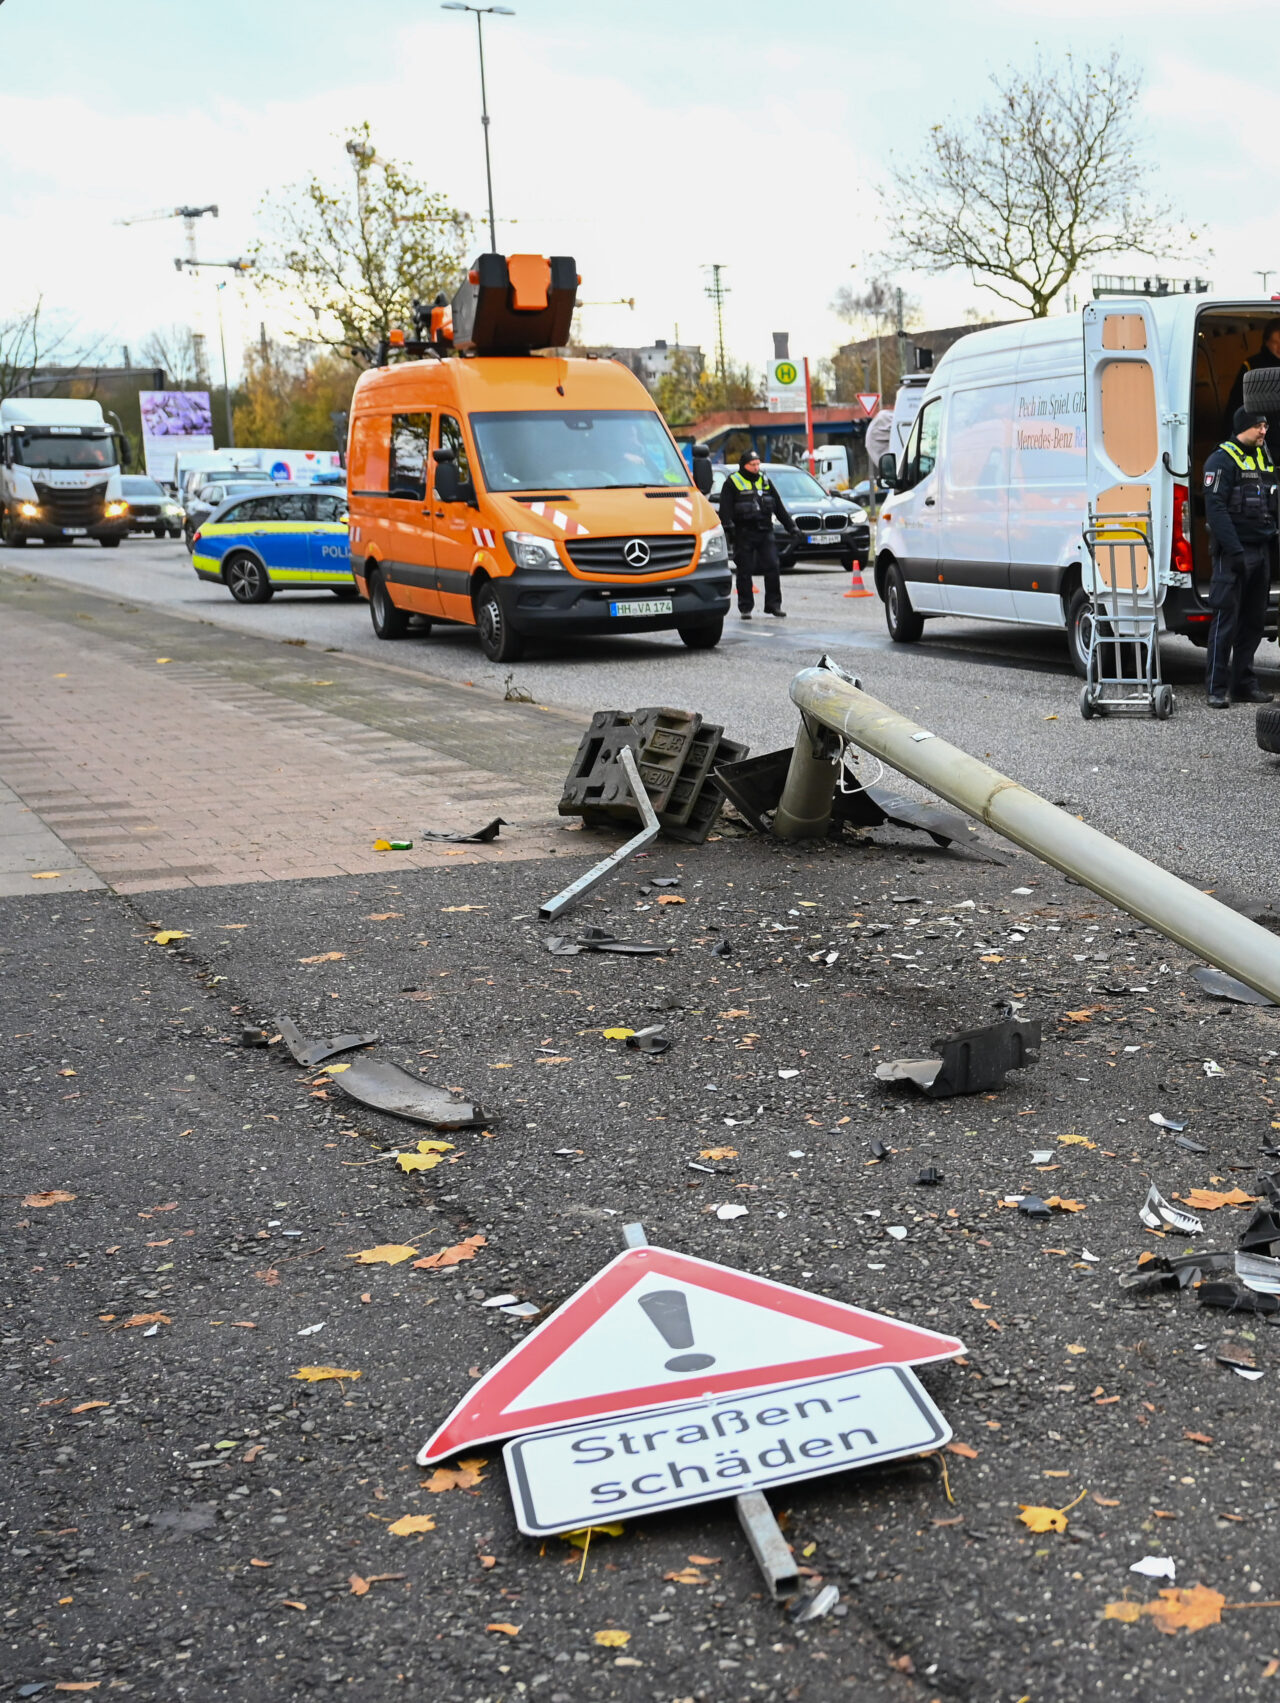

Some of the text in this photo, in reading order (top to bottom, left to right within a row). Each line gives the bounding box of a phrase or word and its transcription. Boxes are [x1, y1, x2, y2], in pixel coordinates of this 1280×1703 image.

[781, 367, 791, 380] H
[1018, 395, 1036, 418] Pech
[1037, 394, 1048, 416] im
[1048, 393, 1070, 420] Spiel.
[1017, 427, 1073, 450] Mercedes-Benz
[617, 602, 671, 614] HH VA 174
[571, 1394, 861, 1464] Straßen-
[590, 1428, 878, 1504] schäden
